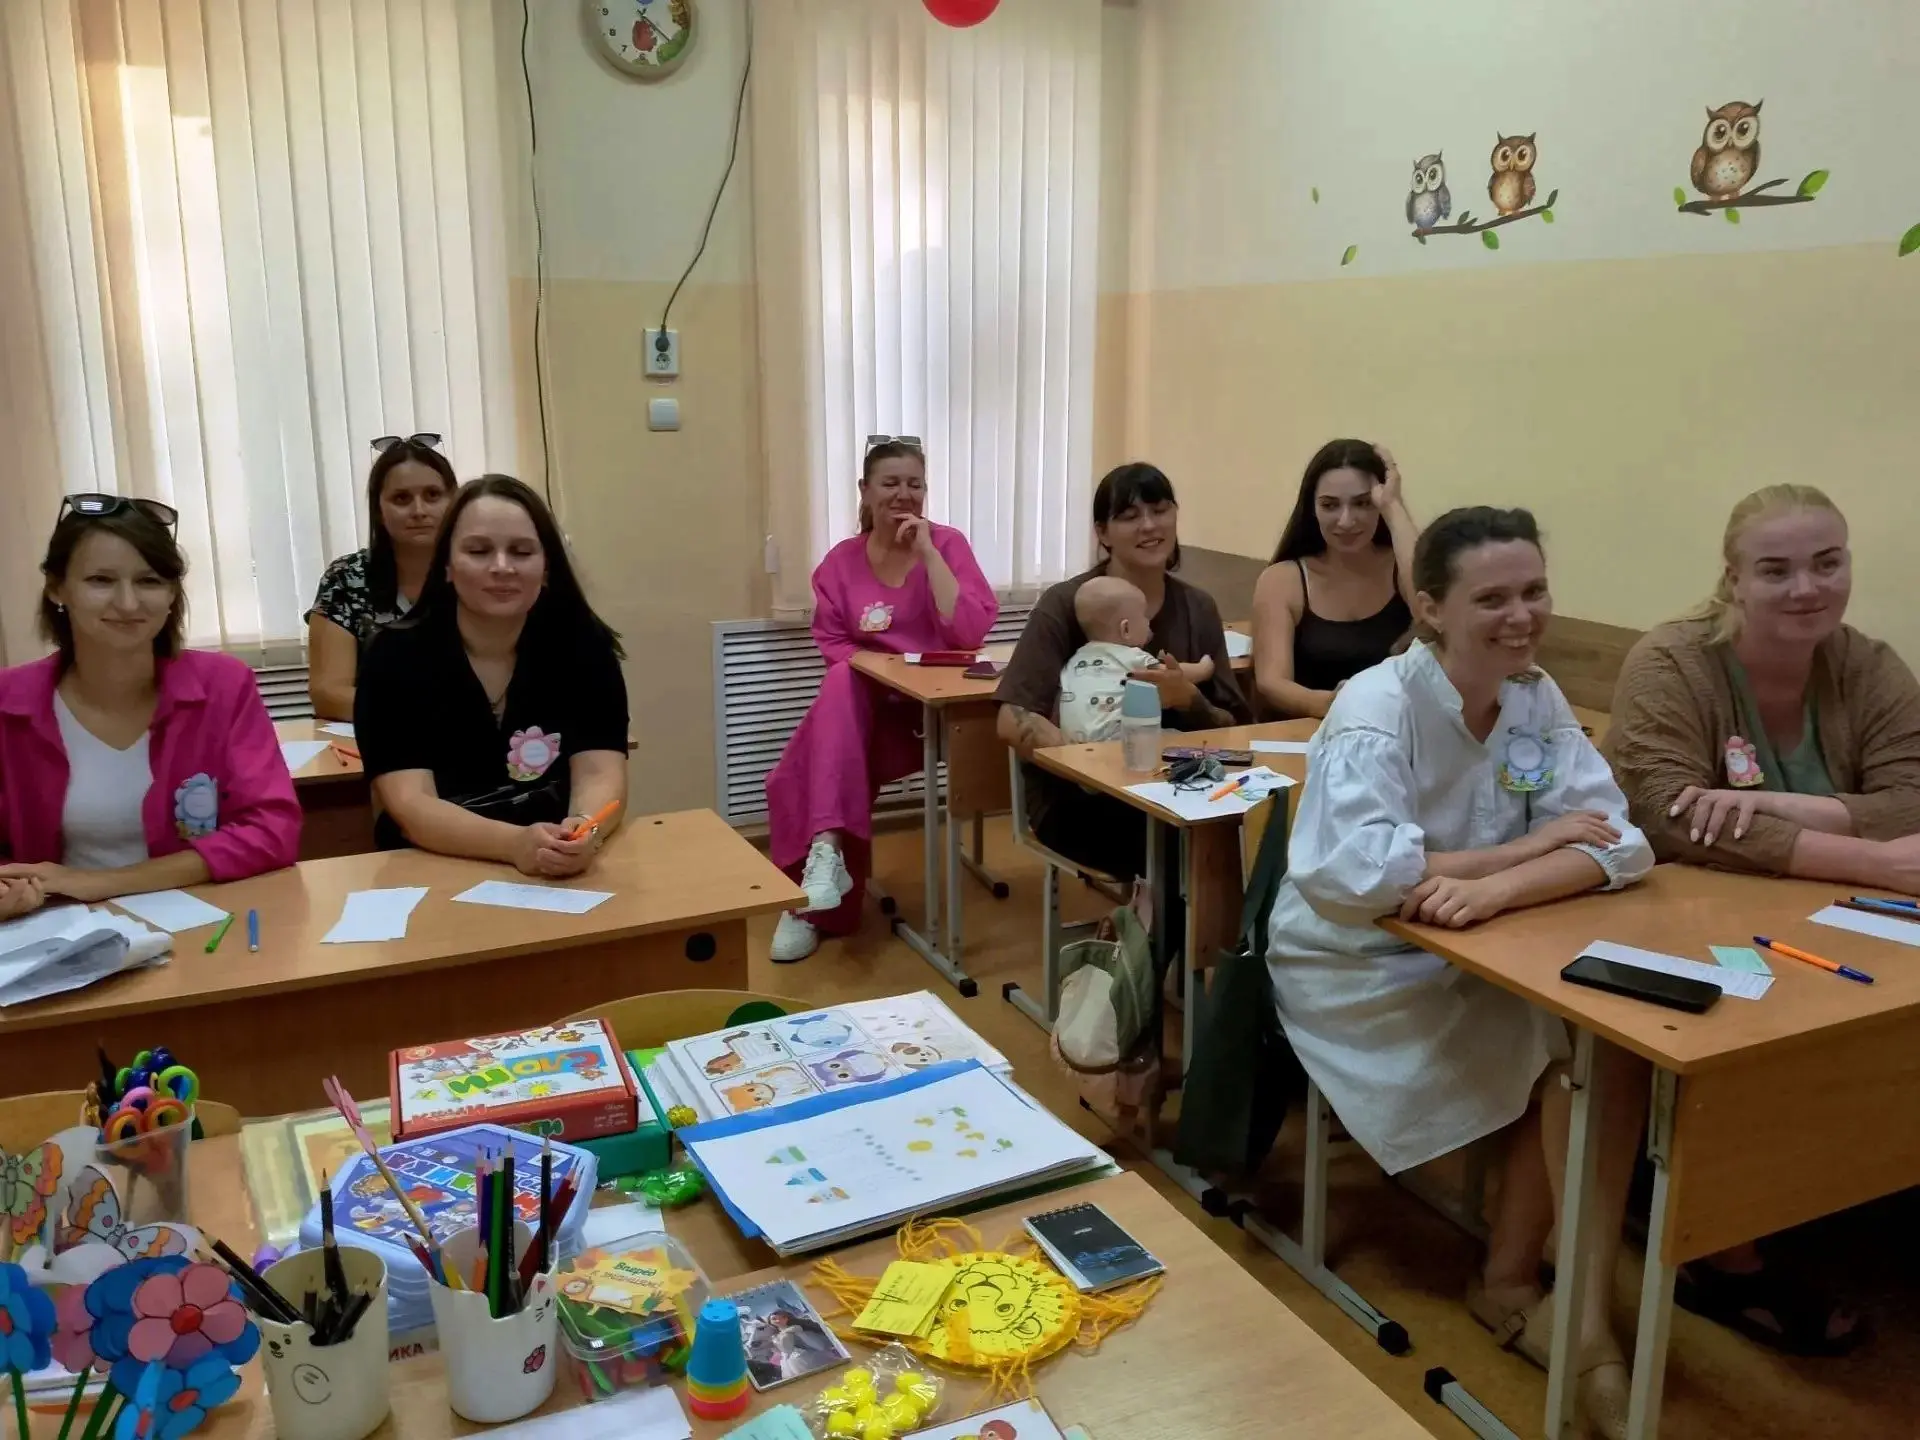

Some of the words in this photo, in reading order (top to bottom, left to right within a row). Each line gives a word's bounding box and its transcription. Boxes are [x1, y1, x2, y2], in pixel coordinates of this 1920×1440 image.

[601, 7, 609, 16] 9
[609, 28, 617, 37] 8
[621, 44, 628, 52] 7
